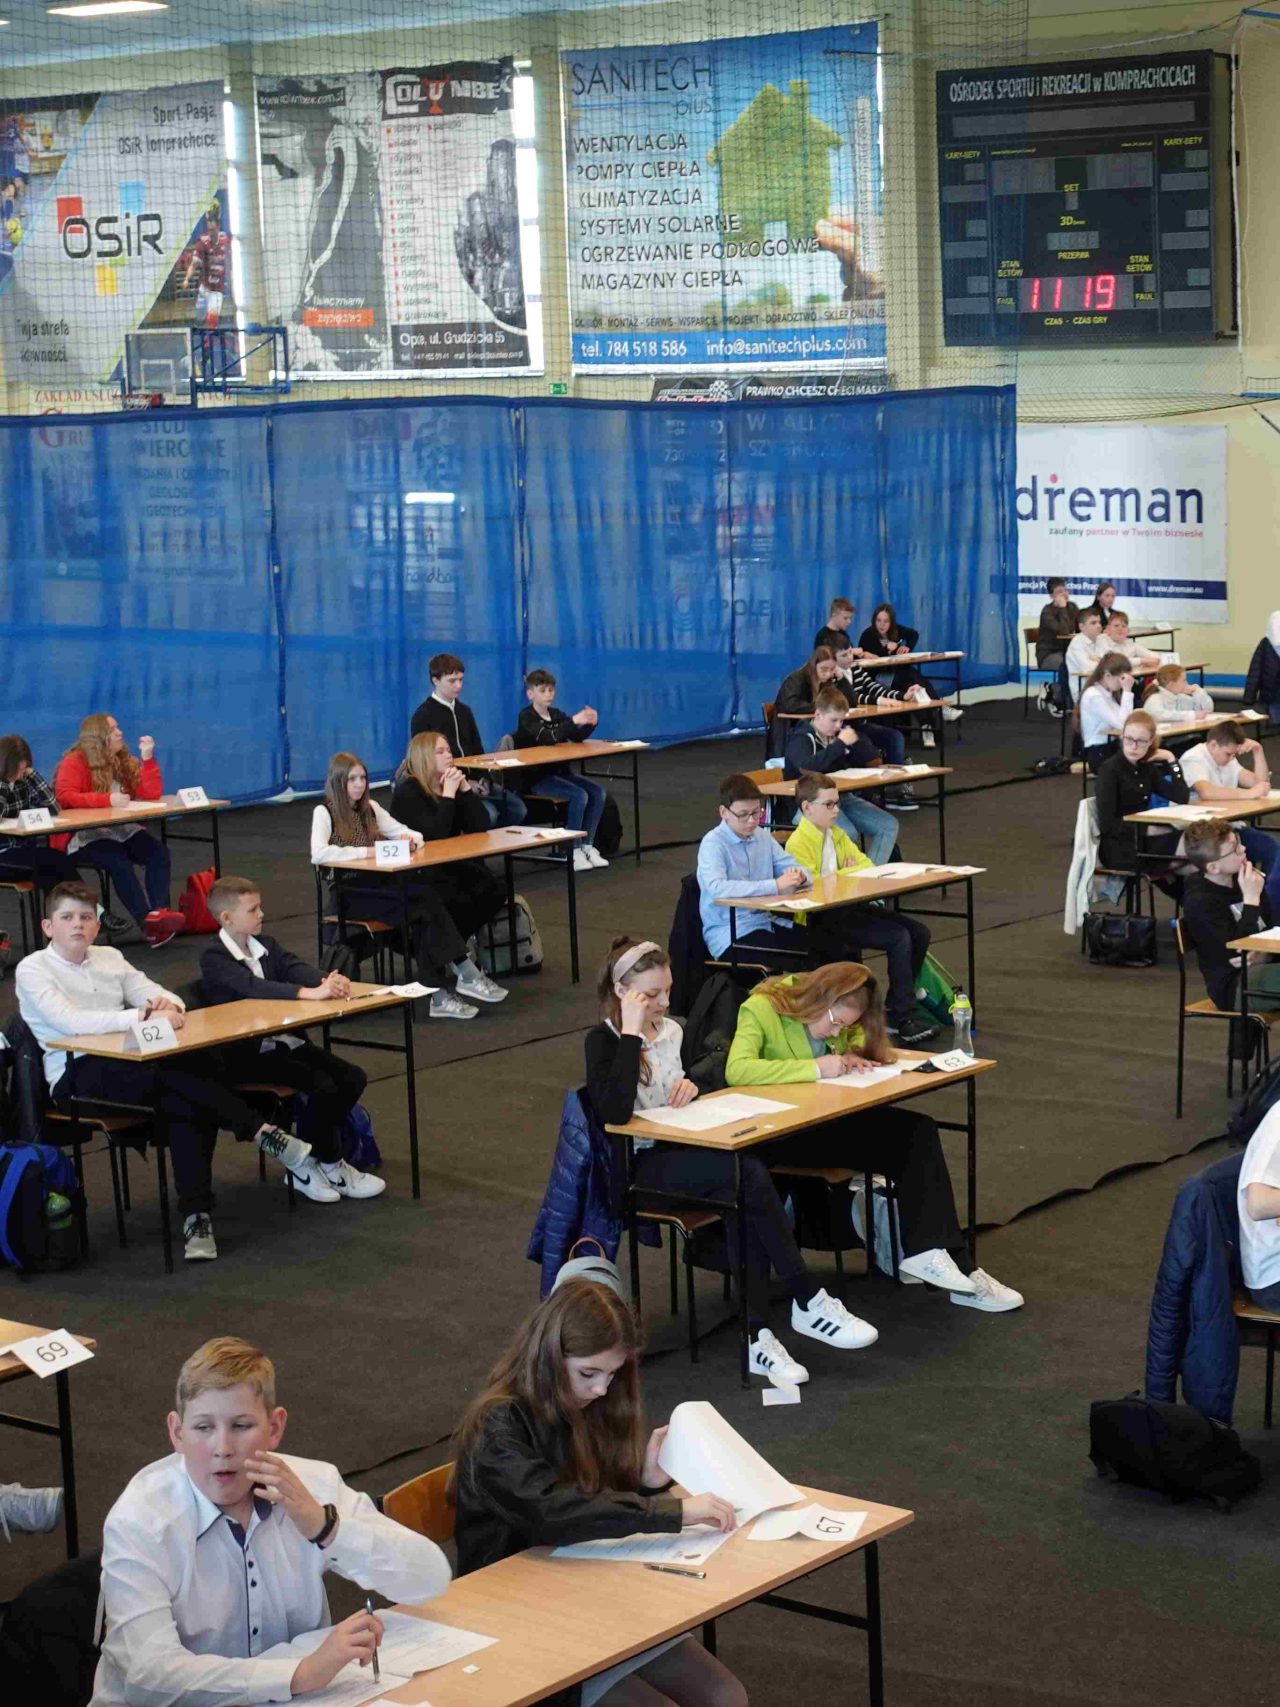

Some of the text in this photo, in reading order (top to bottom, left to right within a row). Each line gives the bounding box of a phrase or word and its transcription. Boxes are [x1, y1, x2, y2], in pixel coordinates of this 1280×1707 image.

[571, 55, 714, 96] SANITECH
[949, 76, 995, 102] OŚRODEK
[996, 77, 1035, 99] SPORTU
[1041, 72, 1092, 96] REKREACJI
[1092, 76, 1102, 92] w
[1103, 64, 1196, 91] KOMPRACHCICACH
[574, 132, 688, 154] WENTYLACJA
[576, 160, 701, 182] POMPY CIEPŁA
[578, 188, 702, 208] KLIMATYZACJA
[580, 214, 740, 236] SYSTEMY SOLARNE
[62, 213, 164, 259] OSiR
[581, 238, 820, 264] OGRZEWANIE PODŁOGOWE
[581, 269, 743, 290] MAGAZYNY CIEPŁA
[581, 334, 867, 358] tel. 784 518 586 info@sanitechplus.com
[745, 385, 783, 397] PRAWKO
[1016, 473, 1204, 524] dreman
[1049, 526, 1083, 537] zaufany
[187, 791, 201, 802] 53
[28, 813, 43, 824] 54
[382, 844, 400, 858] 52
[141, 1025, 164, 1043] 62
[944, 1055, 966, 1069] 63
[36, 1340, 69, 1364] 69
[817, 1515, 844, 1536] 67
